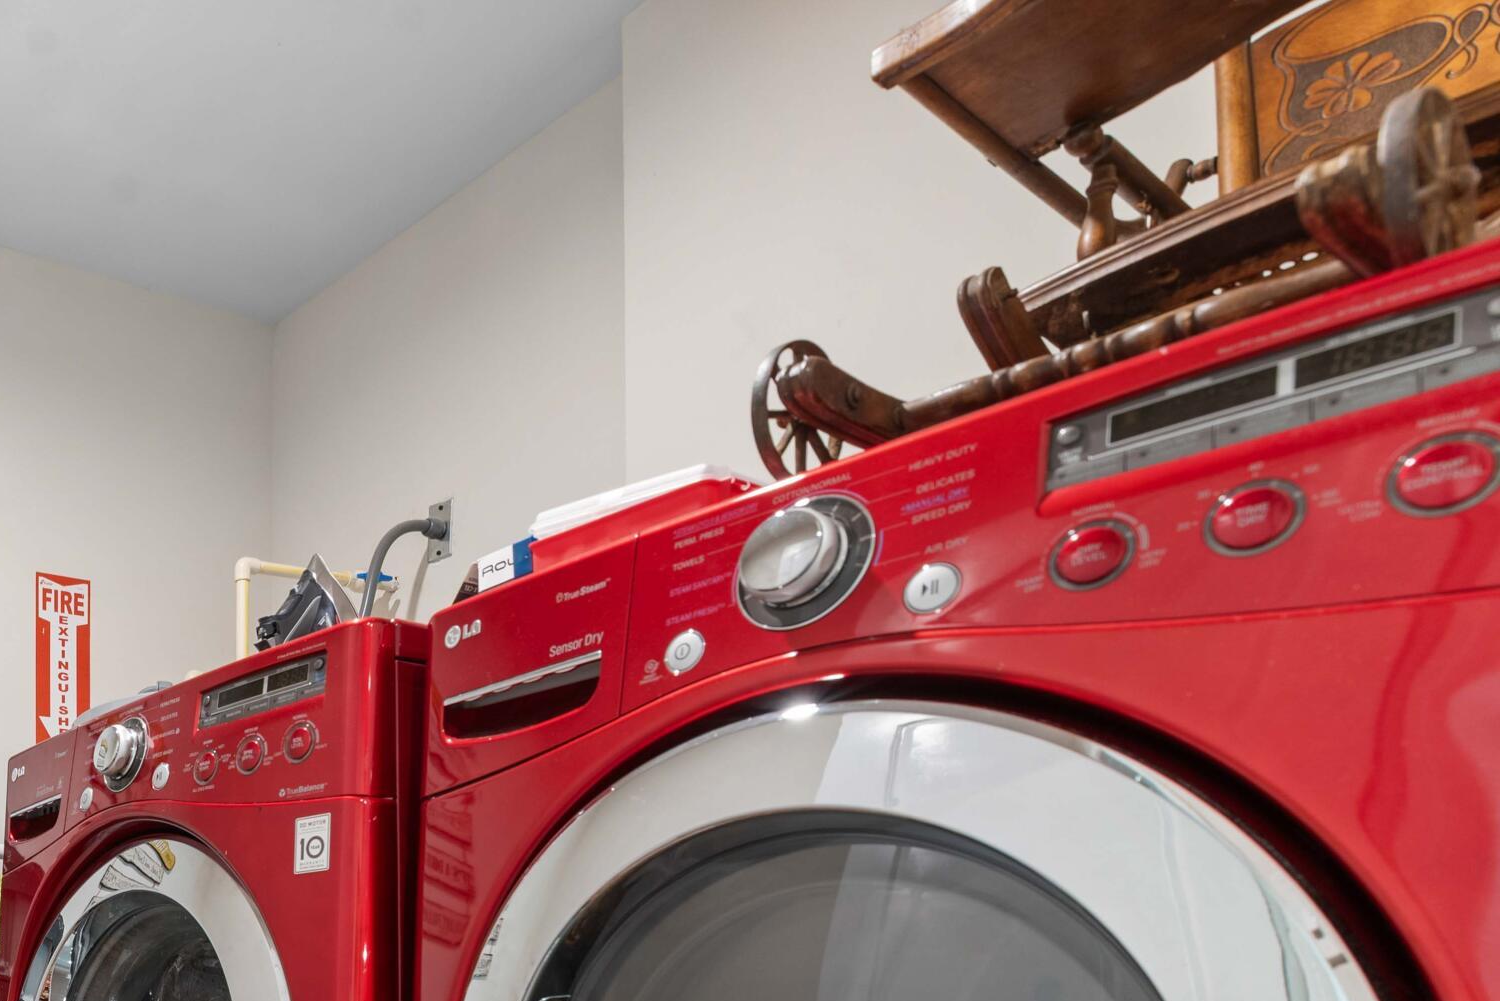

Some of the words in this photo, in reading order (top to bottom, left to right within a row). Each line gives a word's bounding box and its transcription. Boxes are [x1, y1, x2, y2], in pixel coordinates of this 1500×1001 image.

[42, 587, 84, 617] FIRE
[549, 636, 584, 658] Sensor
[584, 631, 604, 648] Dry
[300, 835, 325, 861] 10
